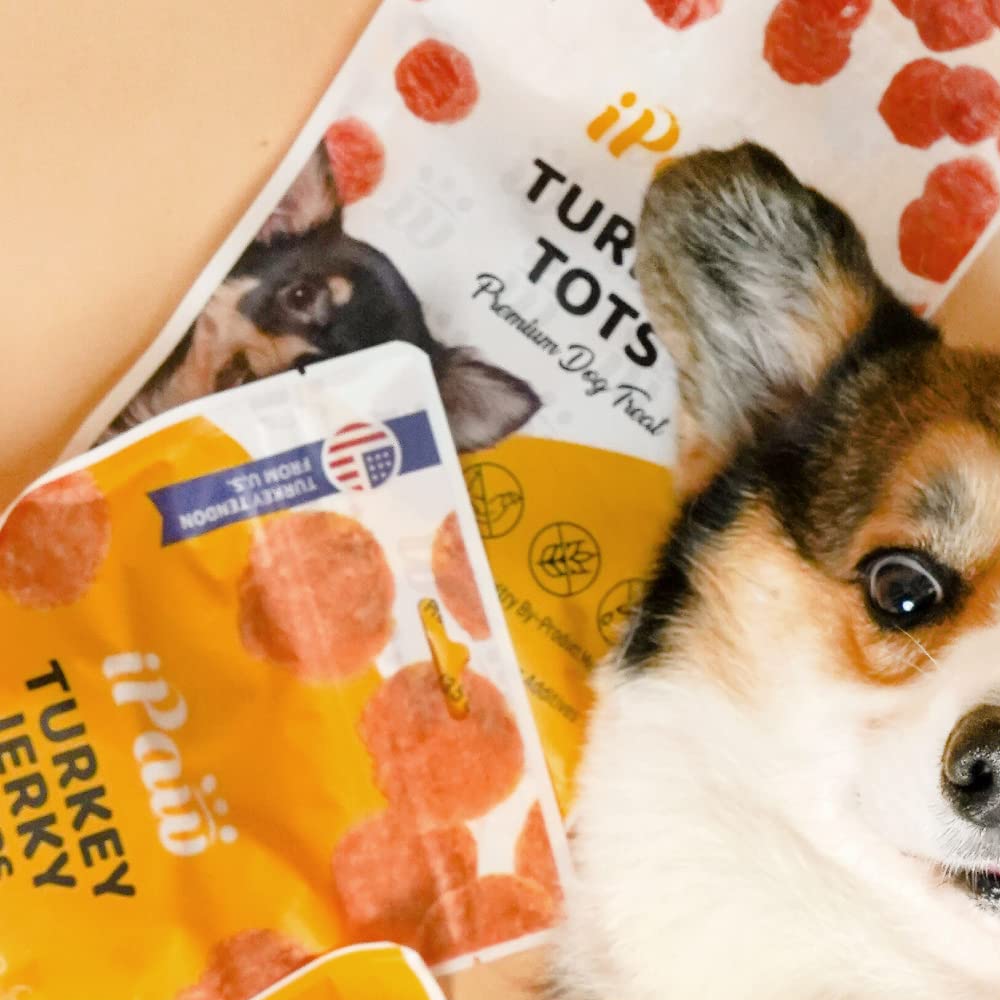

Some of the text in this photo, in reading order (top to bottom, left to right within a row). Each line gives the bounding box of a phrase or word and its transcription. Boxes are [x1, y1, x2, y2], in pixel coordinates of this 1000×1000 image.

[586, 91, 681, 177] iP
[526, 157, 637, 279] TUR
[471, 272, 670, 436] Premium Dog Treat
[528, 236, 659, 367] TOTS
[177, 475, 318, 531] TURKEY TENDON
[262, 456, 313, 484] FROM
[25, 659, 136, 897] TURKEY
[102, 652, 238, 857] iPaw
